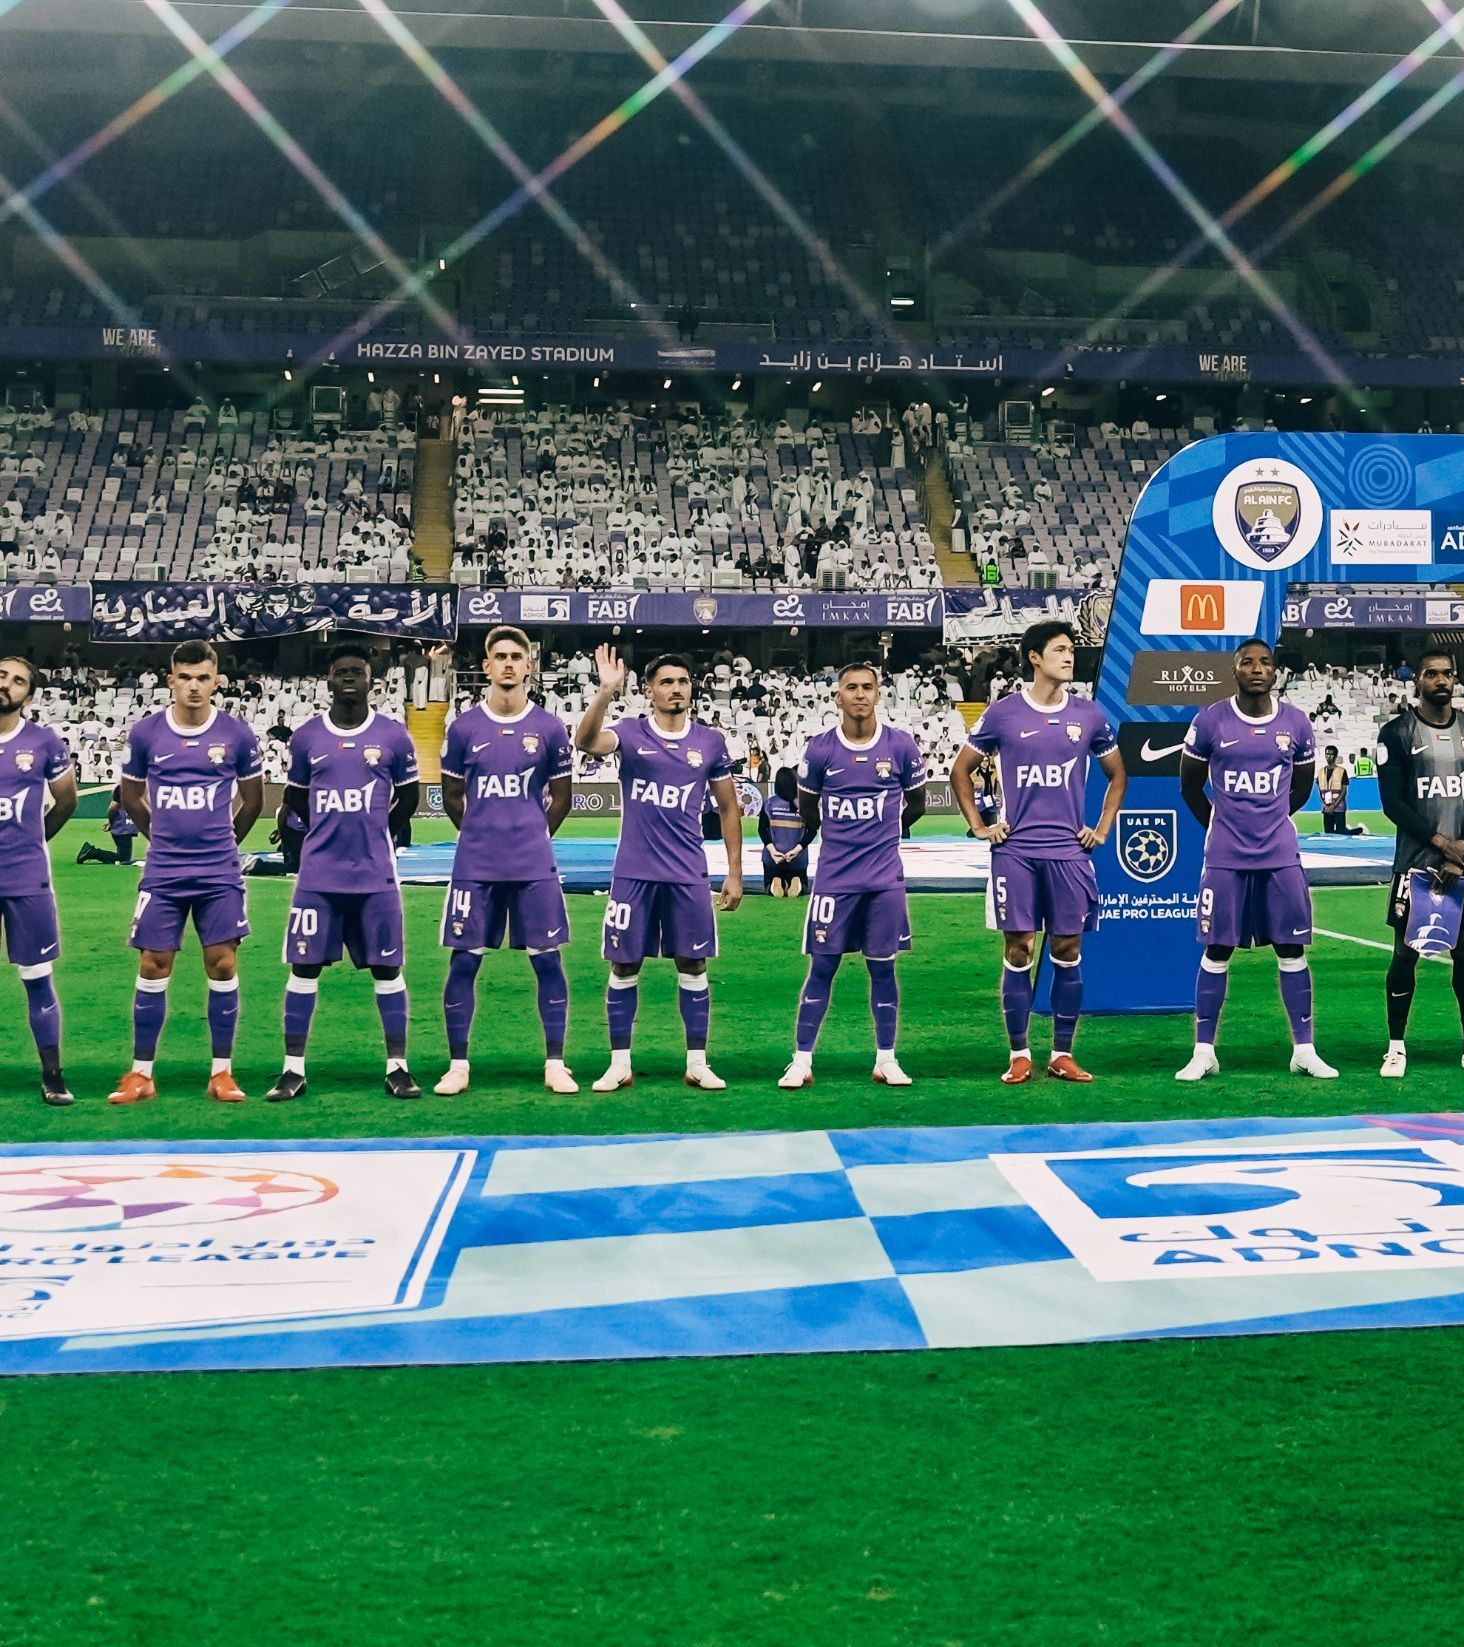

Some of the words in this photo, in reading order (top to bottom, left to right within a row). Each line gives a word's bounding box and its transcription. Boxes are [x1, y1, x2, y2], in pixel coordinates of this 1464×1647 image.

[103, 328, 124, 346] WE
[130, 329, 156, 347] ARE
[357, 343, 422, 359] HAZZA
[427, 344, 458, 359] BIN
[463, 345, 526, 361] ZAYED
[531, 347, 614, 362] STADIUM
[760, 352, 811, 371] زايد
[817, 355, 850, 370] بن
[857, 352, 911, 372] هزاع
[918, 354, 1003, 372] استاد
[1199, 354, 1218, 371] WE
[1223, 355, 1247, 371] ARE
[1244, 496, 1256, 505] AL
[1258, 496, 1277, 505] AIN
[1278, 496, 1292, 505] FC
[588, 601, 627, 618] FAB
[823, 612, 870, 621] IMKAN
[887, 602, 925, 620] FAB
[1368, 614, 1413, 622] IMKAN
[1161, 665, 1214, 682] RIXOS
[572, 794, 603, 811] RO
[1127, 818, 1150, 826] UAE
[1154, 818, 1166, 826] PL
[452, 888, 471, 918] 14
[811, 896, 836, 924] 10
[1201, 887, 1214, 916] 9
[290, 907, 318, 936] 70
[604, 900, 632, 931] 20
[1123, 909, 1149, 919] PRO
[1151, 909, 1198, 919] LEAGUE
[0, 1256, 87, 1267] RO
[106, 1249, 369, 1265] LEAGUE
